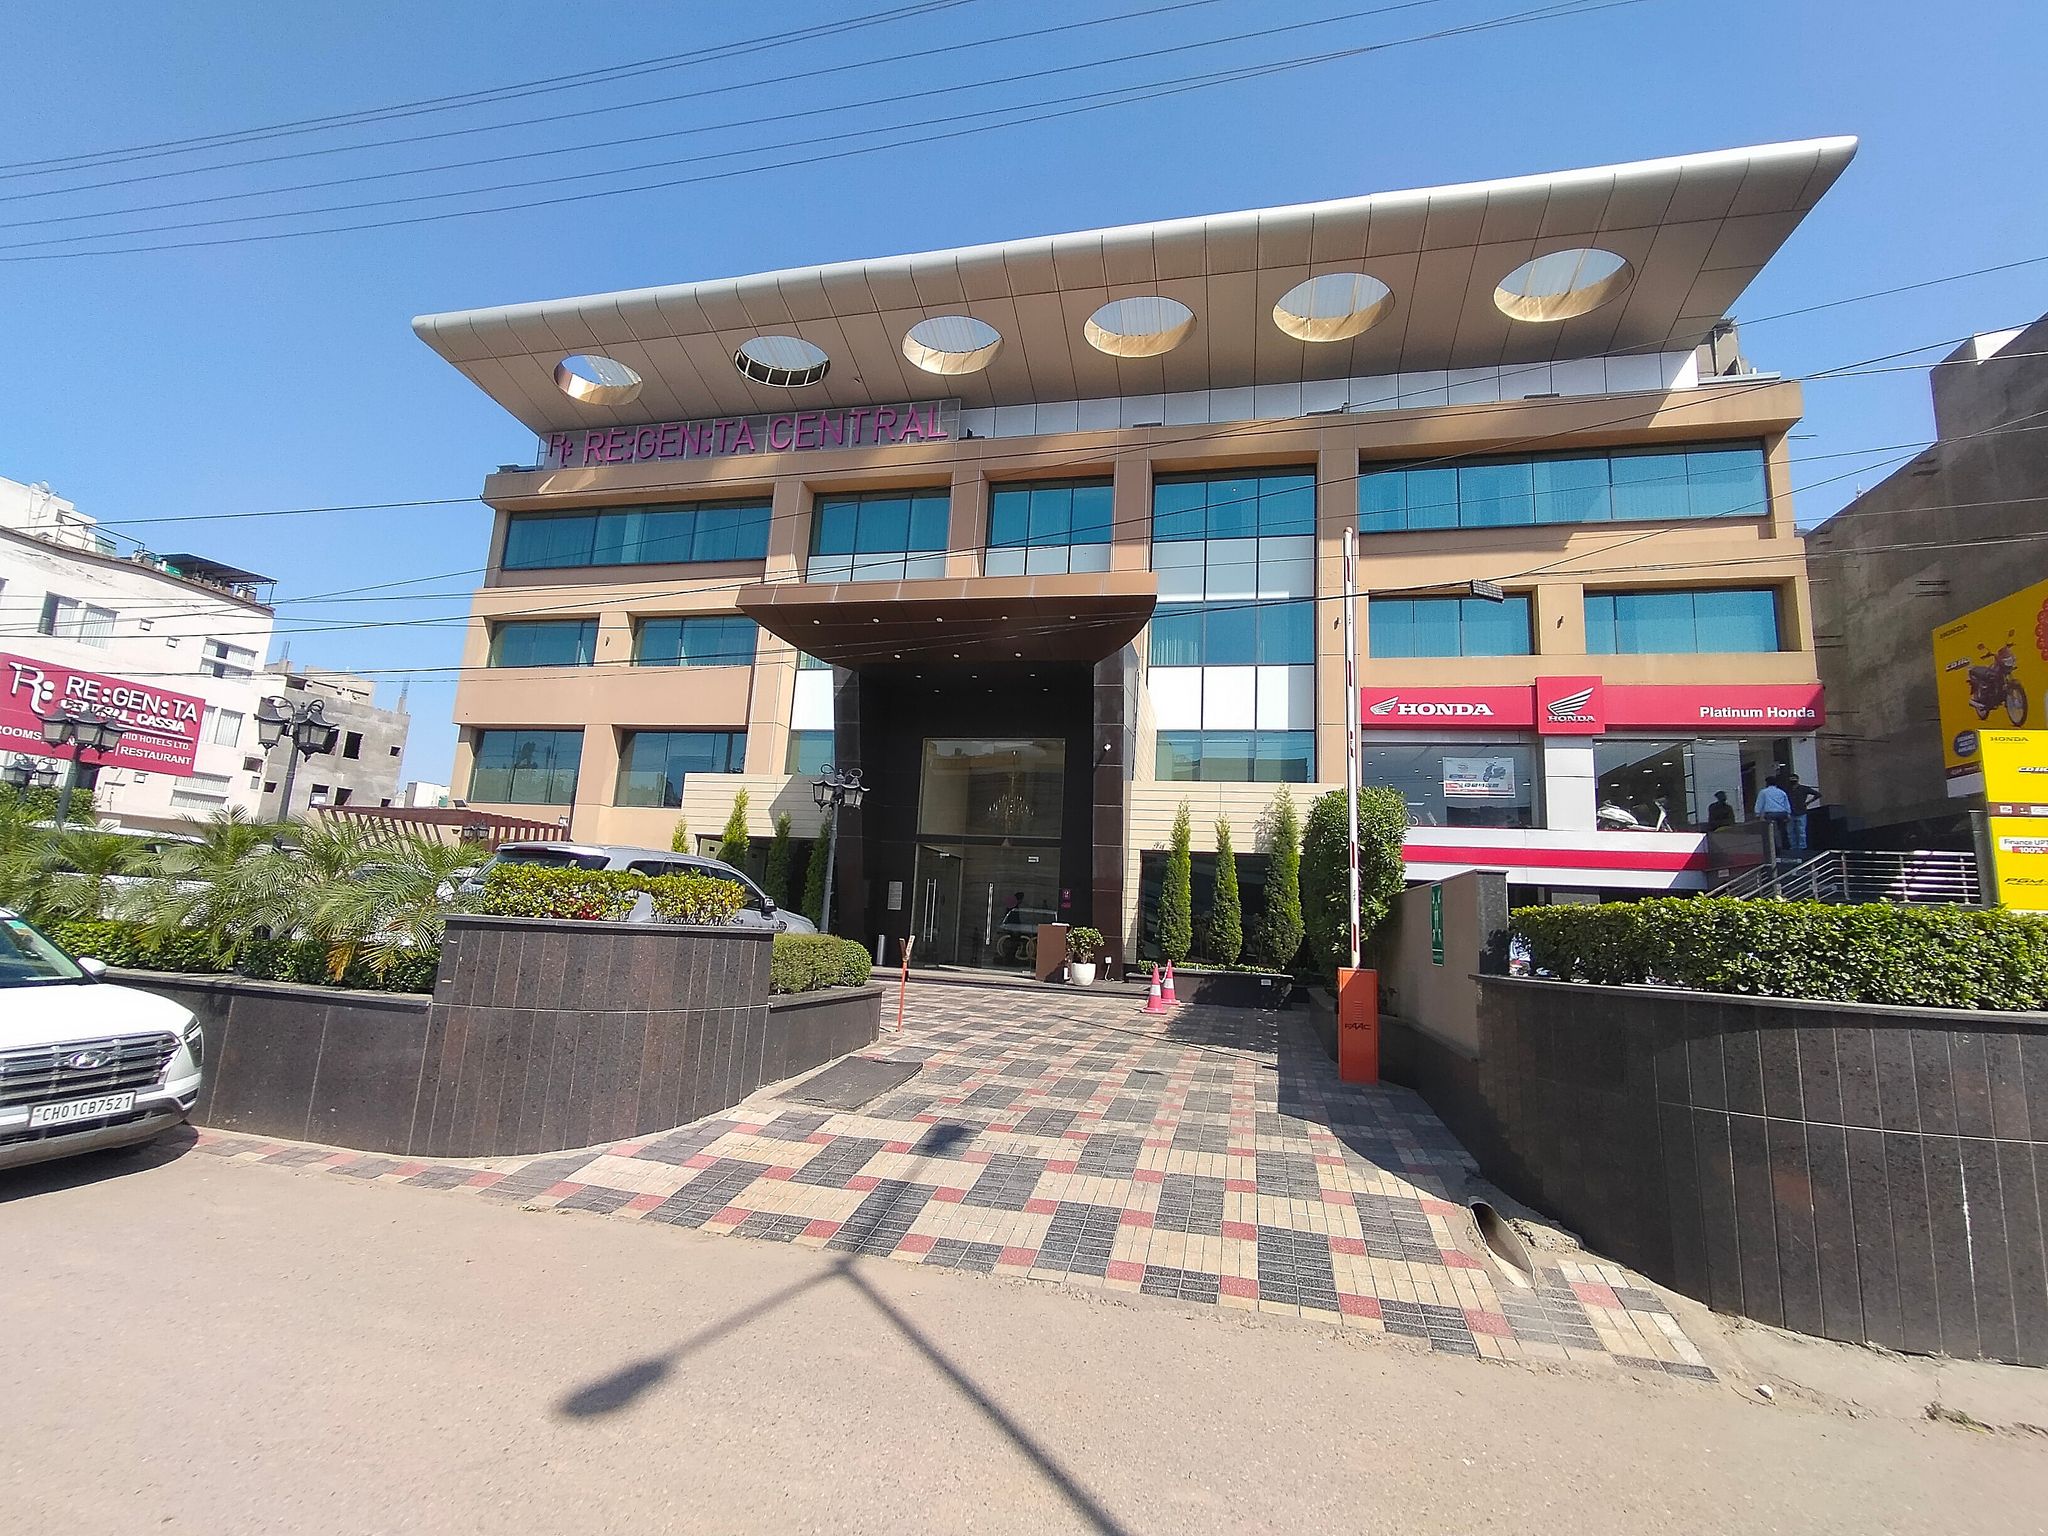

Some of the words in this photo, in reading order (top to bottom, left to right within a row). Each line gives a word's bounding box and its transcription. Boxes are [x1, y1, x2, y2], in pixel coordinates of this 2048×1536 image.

[769, 405, 949, 451] CENTRAL
[1397, 703, 1494, 716] HONDA
[1699, 706, 1763, 718] Platinum
[1767, 706, 1816, 718] Honda
[136, 712, 186, 733] CASSIA
[141, 734, 173, 747] HOTELS
[120, 745, 192, 766] RESTAURANT
[2004, 838, 2033, 846] Finance
[42, 1096, 132, 1121] CH01CB7521
